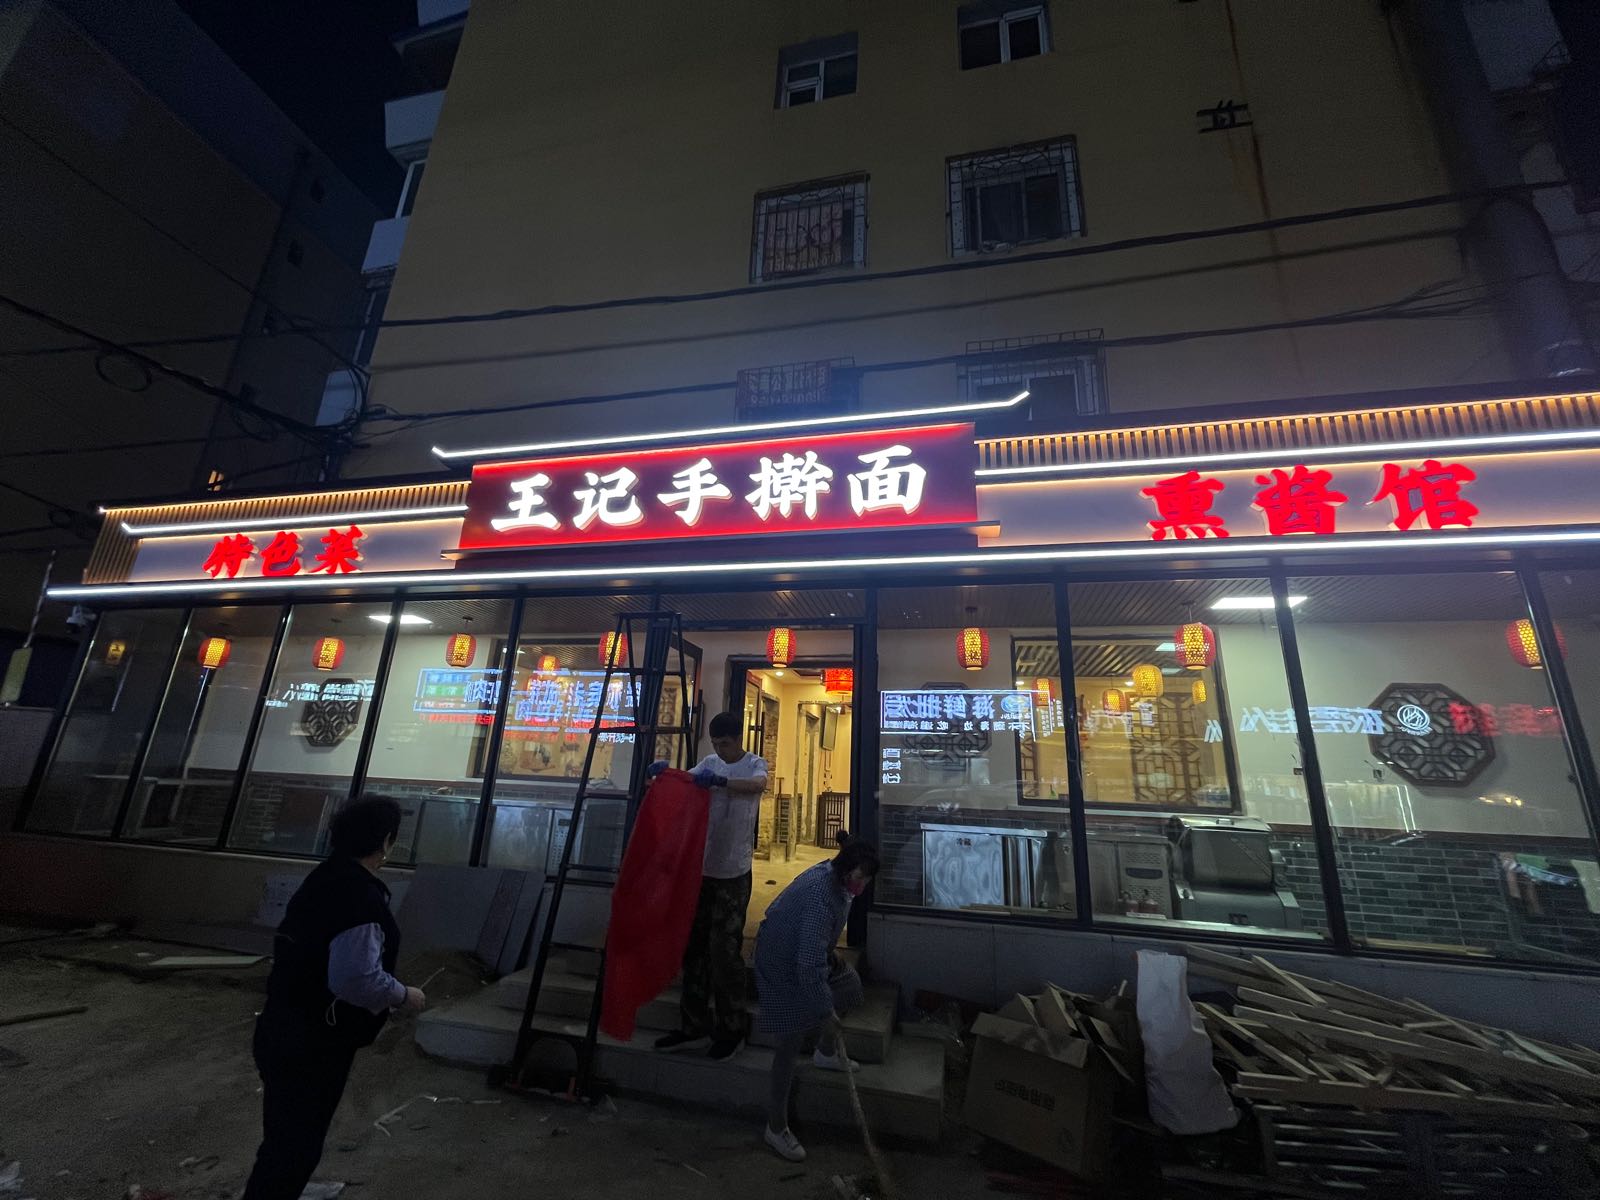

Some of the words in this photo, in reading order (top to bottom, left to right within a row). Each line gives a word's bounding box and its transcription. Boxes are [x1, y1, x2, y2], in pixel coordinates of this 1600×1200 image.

[490, 445, 928, 533] 王记手擀面
[1141, 460, 1480, 541] 熏酱馆
[202, 525, 364, 579] 特色菜
